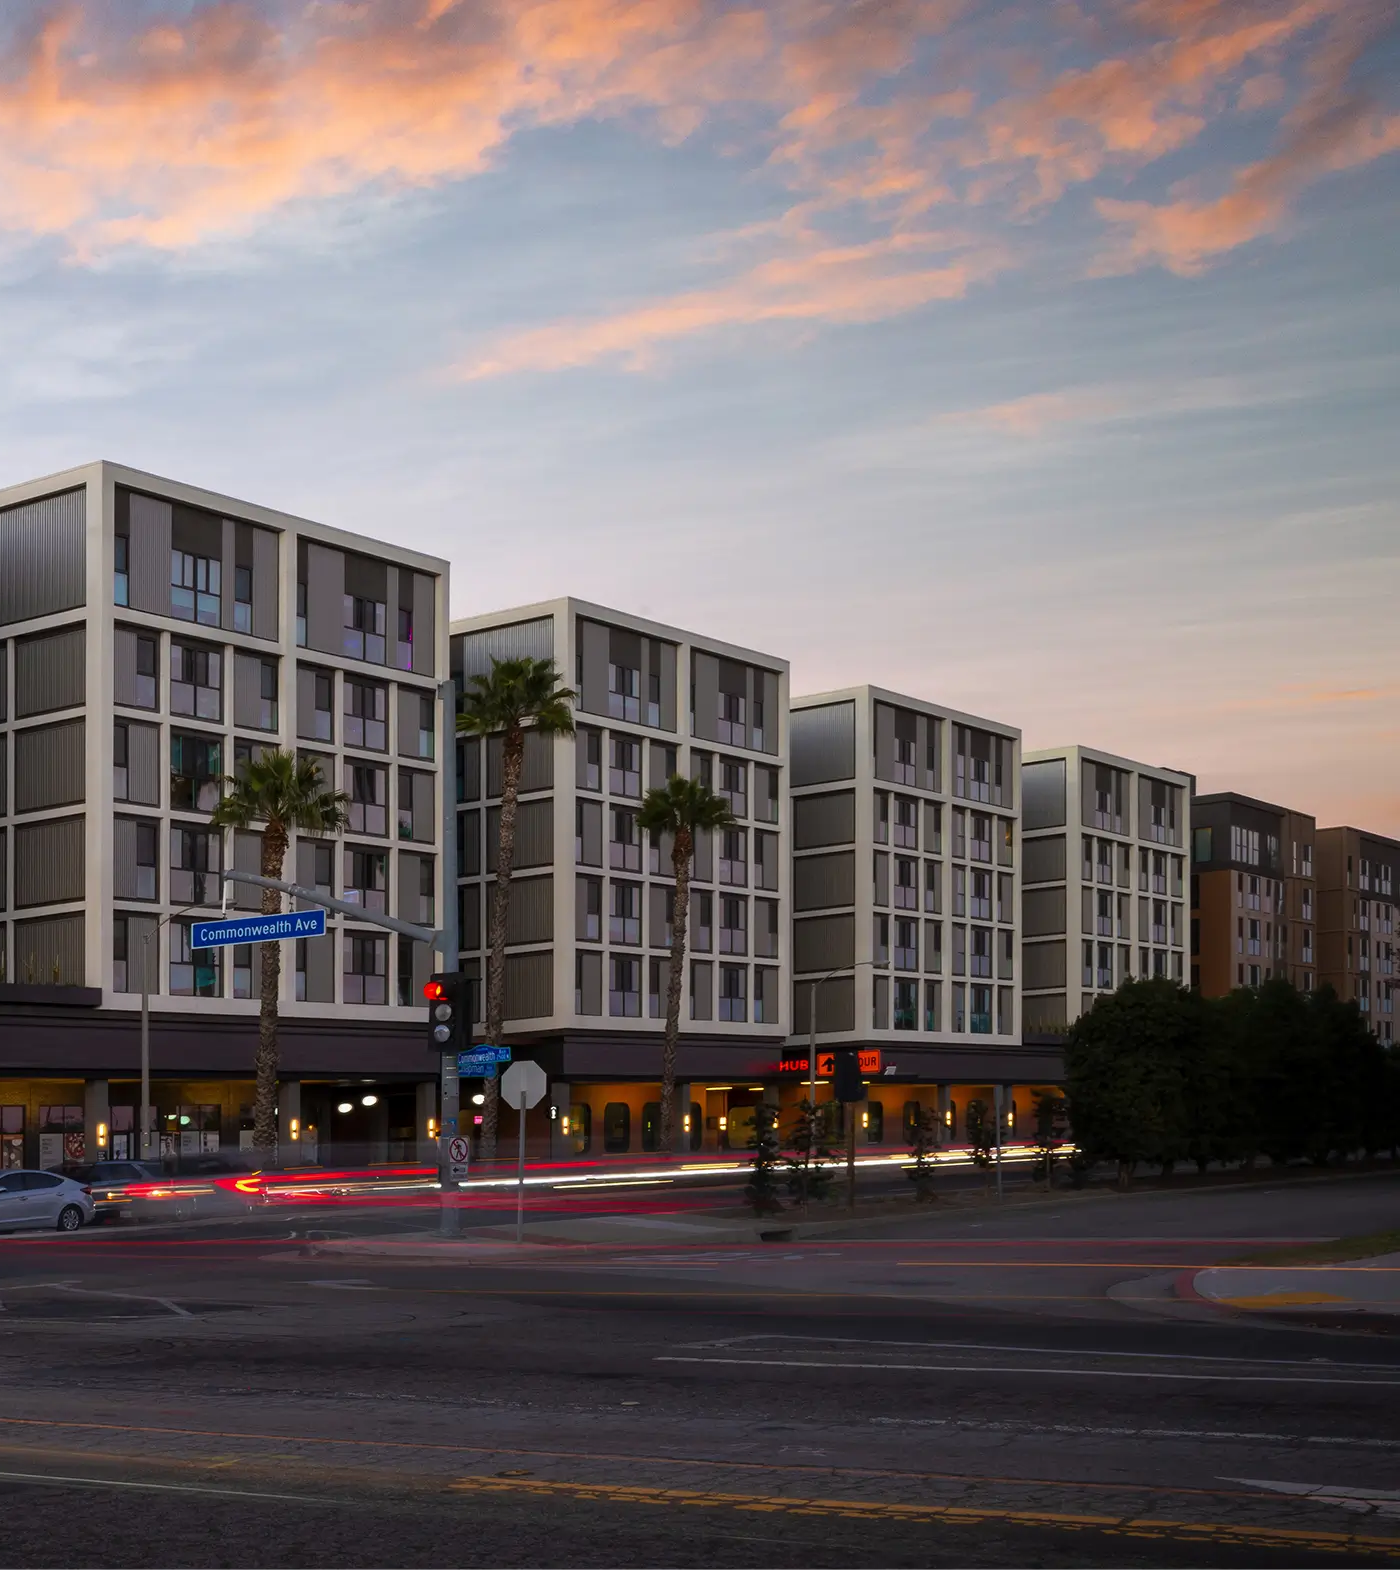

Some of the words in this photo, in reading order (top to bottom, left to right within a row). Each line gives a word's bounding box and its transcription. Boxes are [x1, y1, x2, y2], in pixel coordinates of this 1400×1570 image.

[200, 920, 292, 941] Commonwealth
[295, 918, 318, 932] Ave
[779, 1059, 809, 1072] HUB
[858, 1056, 877, 1067] OUR
